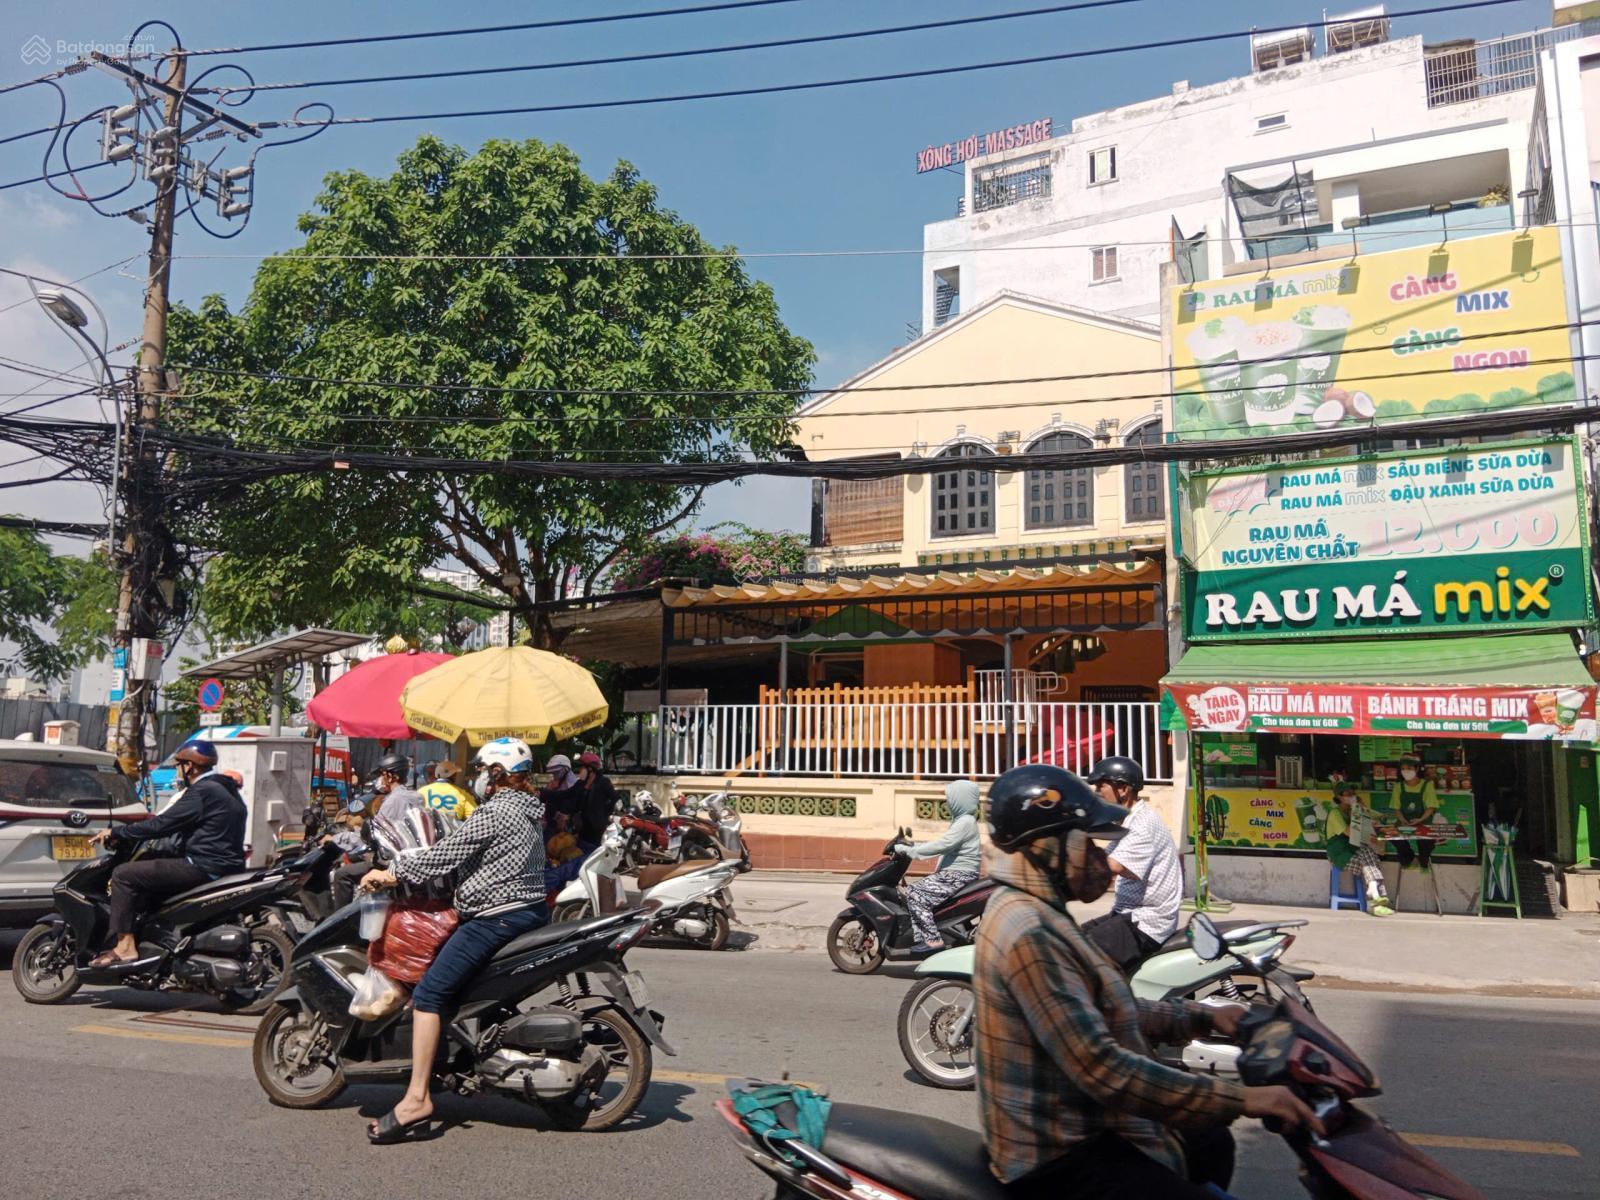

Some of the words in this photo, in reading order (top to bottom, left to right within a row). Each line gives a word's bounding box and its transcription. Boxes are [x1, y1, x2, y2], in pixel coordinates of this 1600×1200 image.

[918, 144, 952, 172] XÔNG
[985, 118, 1052, 155] MASSAGE
[1213, 288, 1260, 308] RAU
[1266, 280, 1299, 300] MÁ
[1302, 273, 1346, 295] mix
[1390, 273, 1457, 301] CÀNG
[1456, 291, 1509, 313] MIX
[1392, 328, 1460, 355] CÀNG
[1453, 350, 1528, 371] NGON
[1280, 473, 1311, 488] RAU
[1315, 468, 1341, 485] MÁ
[1344, 465, 1384, 483] mix
[1424, 458, 1474, 476] RIÊNG
[1478, 453, 1512, 471] SỮA
[1516, 449, 1553, 467] DỪA
[1281, 496, 1312, 510] RAU
[1315, 490, 1342, 507] MÁ
[1344, 487, 1385, 505] mix
[1389, 484, 1425, 503] ĐẬU
[1429, 482, 1476, 498] XANH
[1479, 477, 1514, 493] SỮA
[1518, 473, 1554, 491] DỪA
[1249, 525, 1292, 543] RAU
[1294, 518, 1329, 540] MÁ
[1222, 543, 1301, 566] NGUYÊN
[1305, 533, 1360, 559] CHẤT
[1205, 587, 1320, 626] RAU
[1332, 570, 1422, 620] MÁ
[1433, 566, 1550, 615] mix
[1207, 709, 1240, 725] NGAY
[1247, 695, 1283, 713] RAU
[1286, 691, 1315, 713] MÁ
[1318, 695, 1354, 714] MIX
[1367, 692, 1419, 715] BÁNH
[1423, 693, 1487, 717] TRÁNG
[1491, 697, 1529, 718] MIX
[1262, 717, 1278, 726] Cho
[1279, 717, 1294, 726] hóa
[1323, 719, 1339, 727] 60K
[1406, 720, 1423, 730] Cho
[1425, 720, 1441, 730] hóa
[428, 788, 458, 811] be
[1266, 810, 1285, 818] MIX
[1263, 832, 1288, 840] NGON
